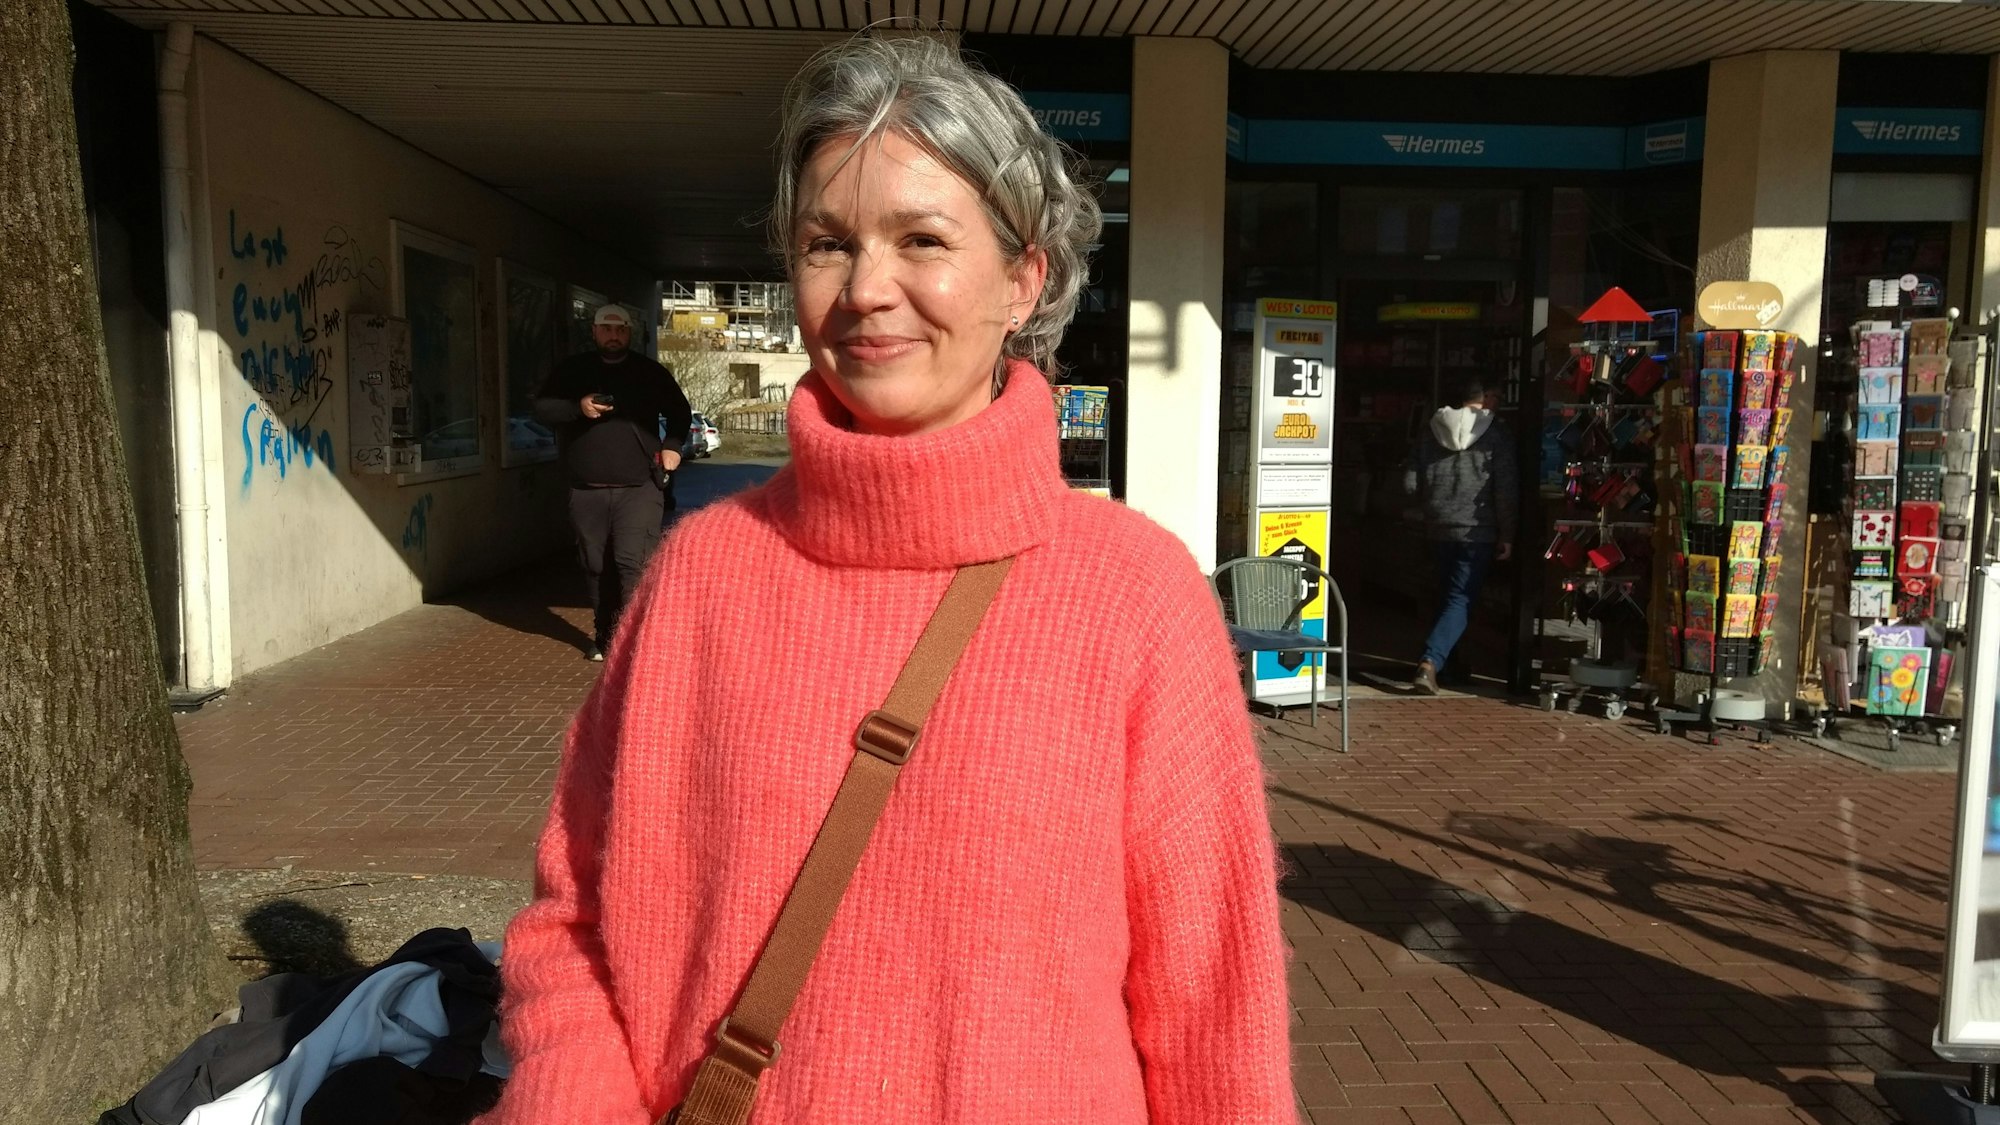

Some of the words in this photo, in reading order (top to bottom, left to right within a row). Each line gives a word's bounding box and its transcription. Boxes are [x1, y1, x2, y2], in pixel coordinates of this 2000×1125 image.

[1033, 108, 1101, 126] ermes
[1877, 121, 1960, 141] Hermes
[1406, 135, 1485, 154] Hermes
[1266, 302, 1293, 312] WEST
[1303, 304, 1334, 315] LOTTO
[1280, 330, 1319, 342] FREITAG
[1755, 334, 1767, 351] 8
[1292, 358, 1323, 396] 30
[1752, 371, 1766, 387] 9
[1283, 413, 1308, 426] EURO
[1744, 412, 1768, 426] 10
[1273, 425, 1316, 438] JACKPOT
[1740, 447, 1763, 462] 10
[1737, 525, 1756, 539] 12
[1283, 545, 1306, 553] JACKPOT
[1735, 562, 1754, 575] 13
[1732, 600, 1749, 611] 14
